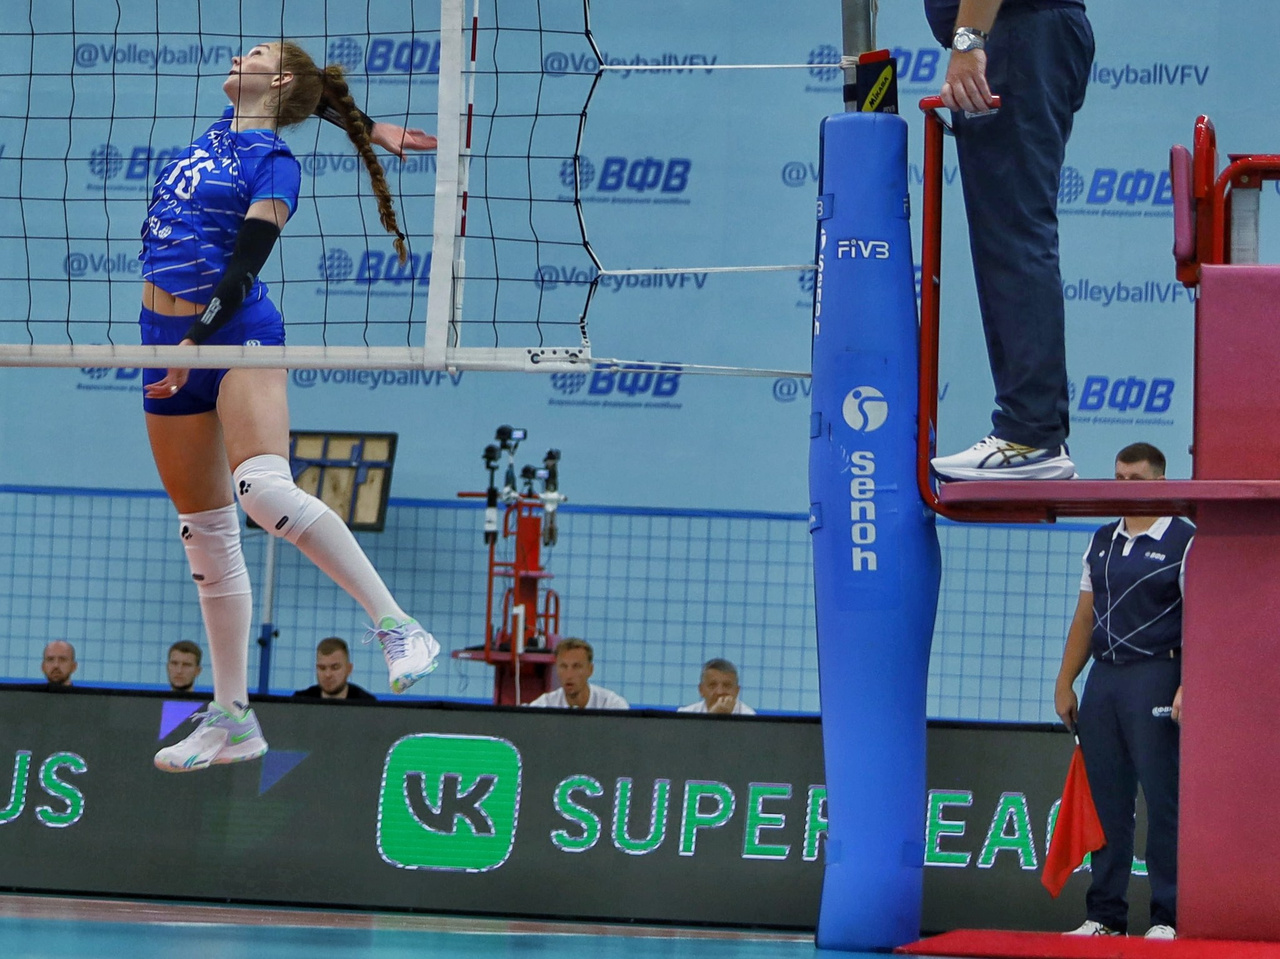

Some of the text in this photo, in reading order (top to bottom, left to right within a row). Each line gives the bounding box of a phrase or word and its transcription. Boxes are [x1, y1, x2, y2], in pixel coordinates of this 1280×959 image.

[597, 156, 692, 194] ВФВ
[588, 359, 684, 398] ВФВ
[1078, 375, 1176, 413] ВФВ
